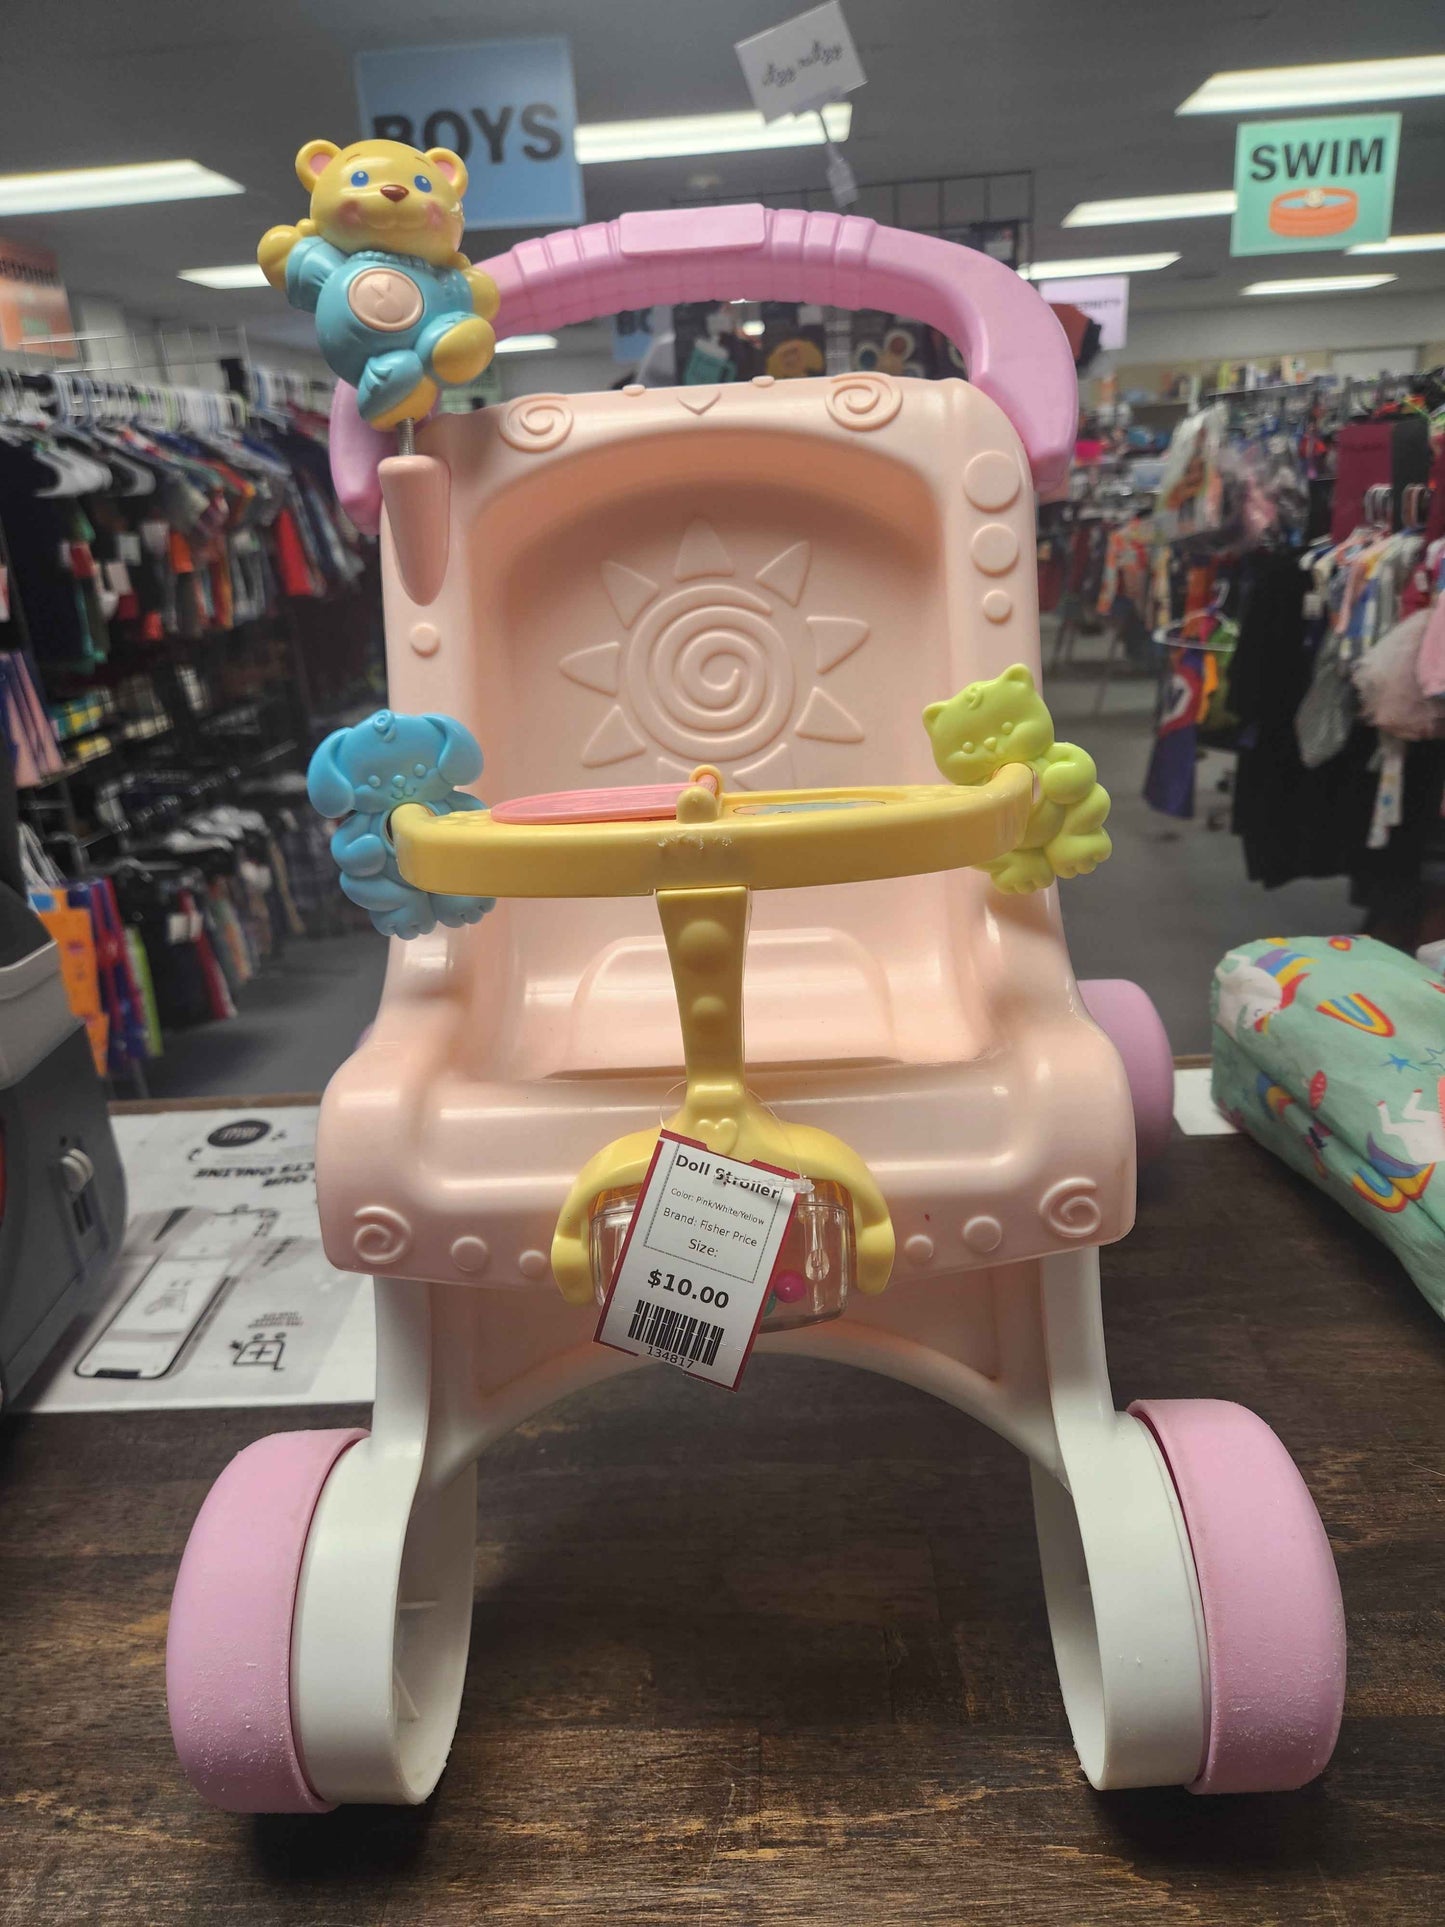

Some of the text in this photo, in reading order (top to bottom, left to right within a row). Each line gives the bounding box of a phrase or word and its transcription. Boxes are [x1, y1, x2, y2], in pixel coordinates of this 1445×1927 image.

[372, 103, 563, 165] BOYS
[1251, 137, 1384, 181] SWIM
[675, 1154, 779, 1199] Doll Stroller
[671, 1188, 765, 1225] Color: Pink/White/Yellow
[663, 1207, 757, 1247] Brand: Fisher Price
[688, 1238, 718, 1258] Size:
[647, 1269, 730, 1309] $10.00
[646, 1346, 694, 1369] 134817
